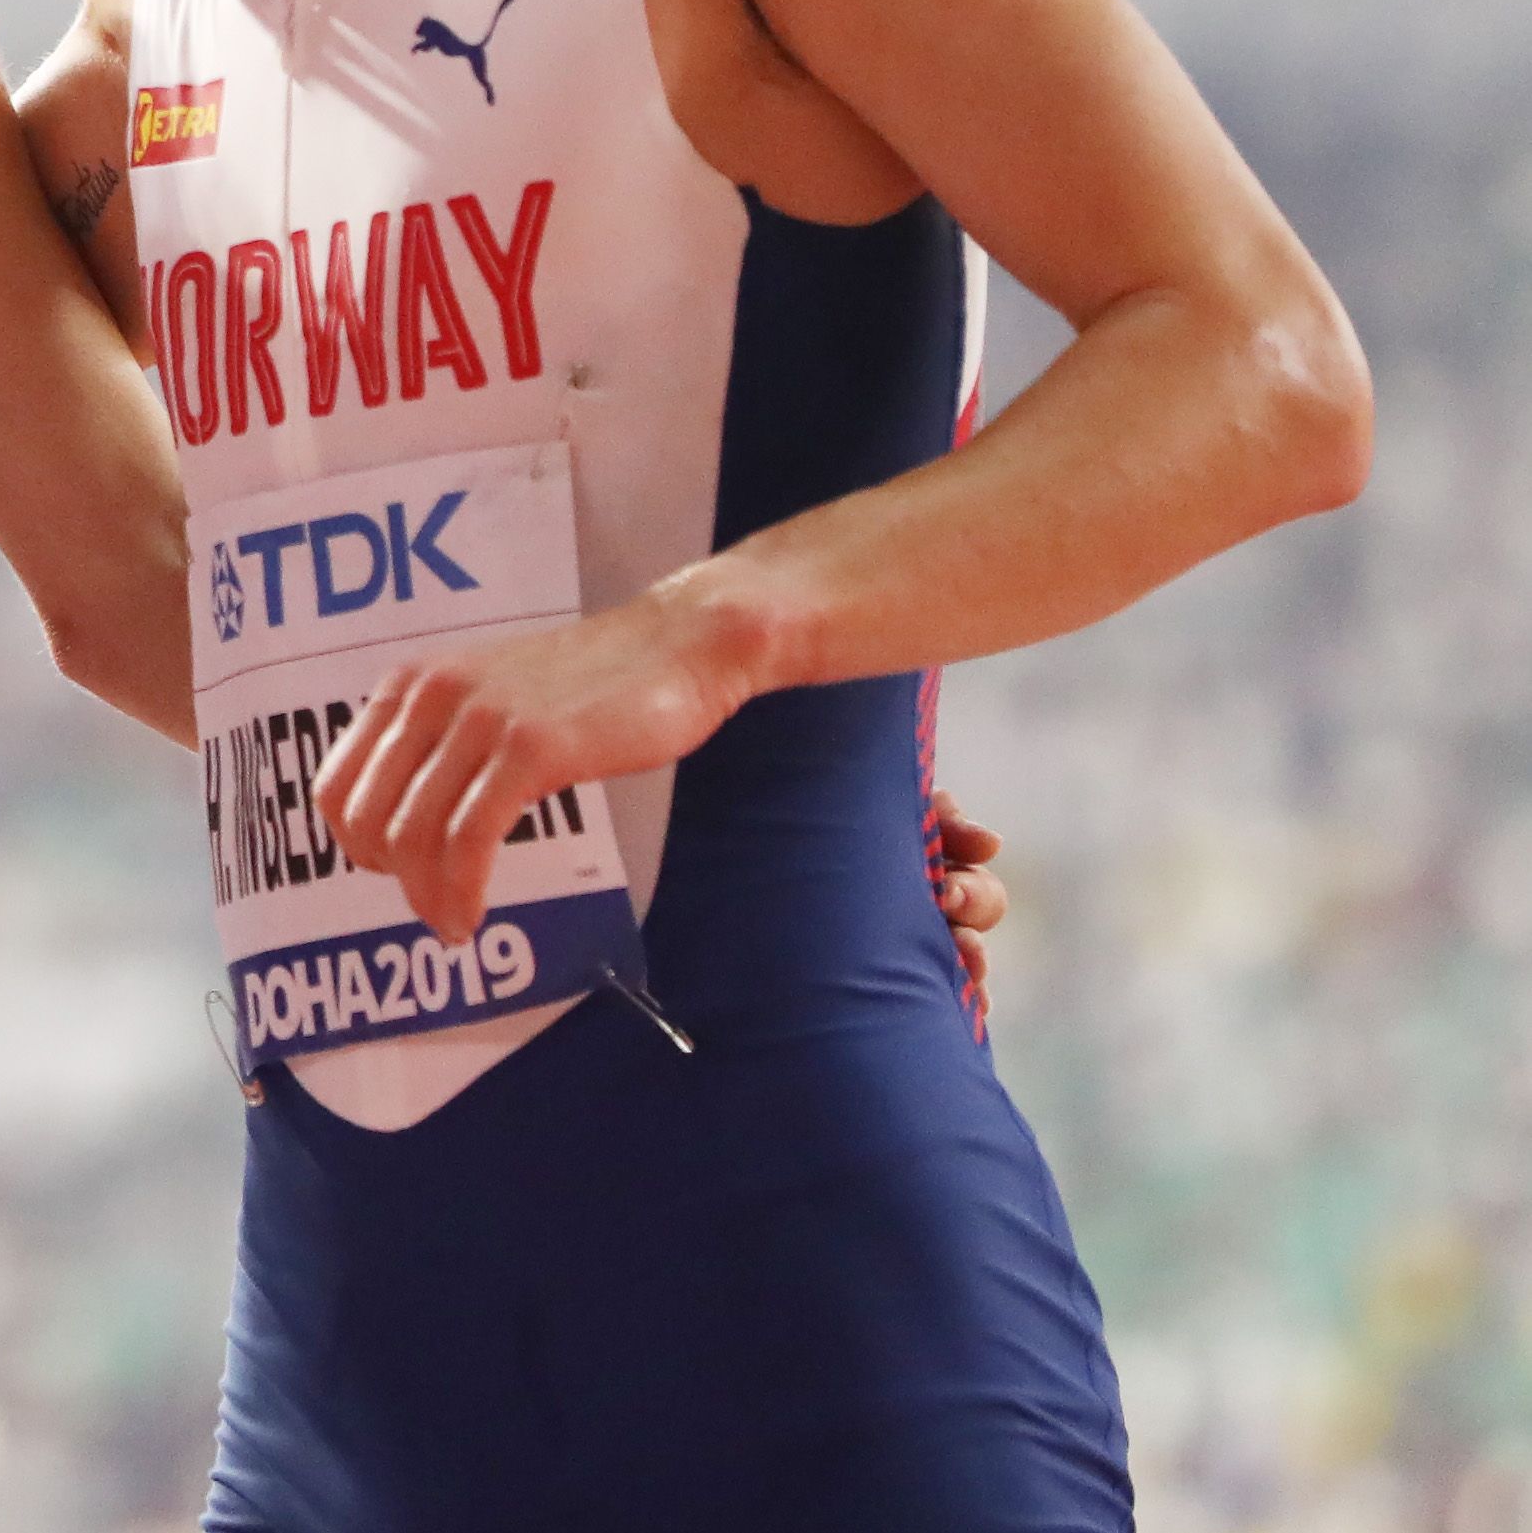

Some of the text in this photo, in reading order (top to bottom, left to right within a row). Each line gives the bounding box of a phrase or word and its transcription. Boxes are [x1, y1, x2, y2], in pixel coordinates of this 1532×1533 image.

[151, 102, 218, 143] ETRA
[238, 490, 481, 629] TDK
[204, 735, 233, 908] H.
[244, 922, 536, 1049] DOHA2019
